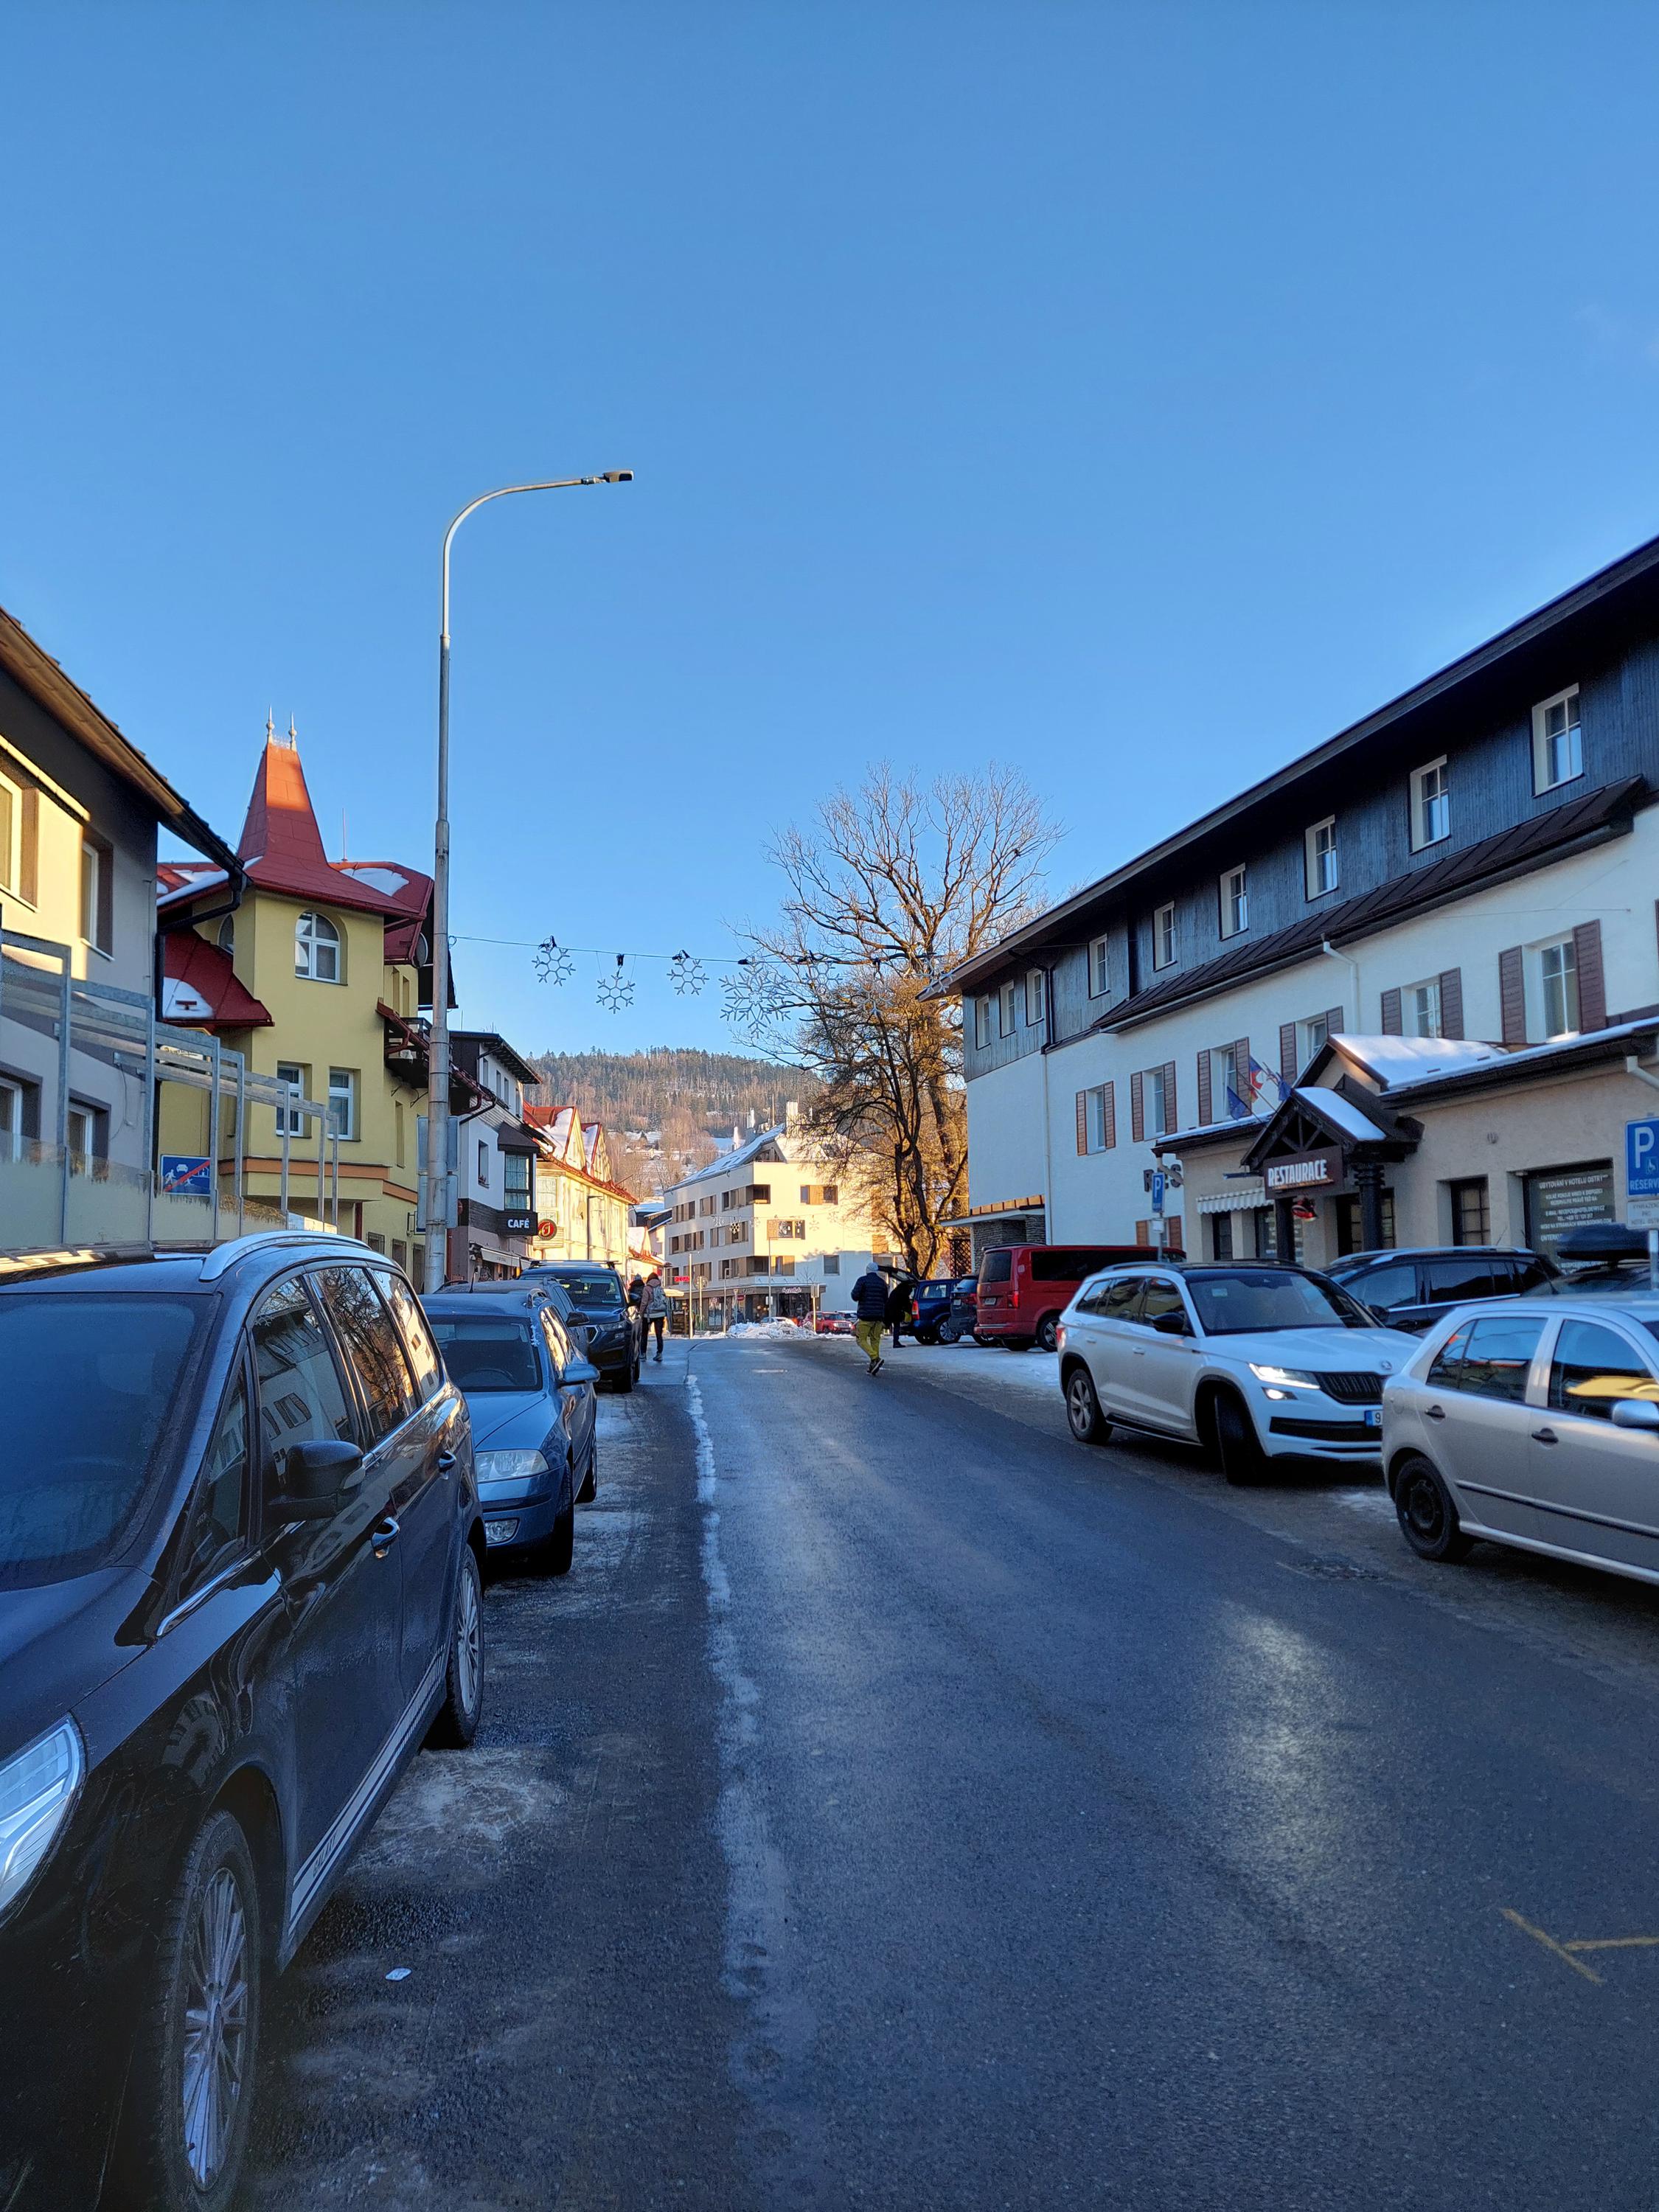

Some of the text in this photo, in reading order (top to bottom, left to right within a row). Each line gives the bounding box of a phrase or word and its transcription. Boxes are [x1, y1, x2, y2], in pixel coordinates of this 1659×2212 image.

[1635, 1127, 1655, 1169] P
[1268, 1159, 1327, 1187] RESTAURACE
[1154, 1178, 1161, 1198] P
[508, 1218, 529, 1228] CAFÉ
